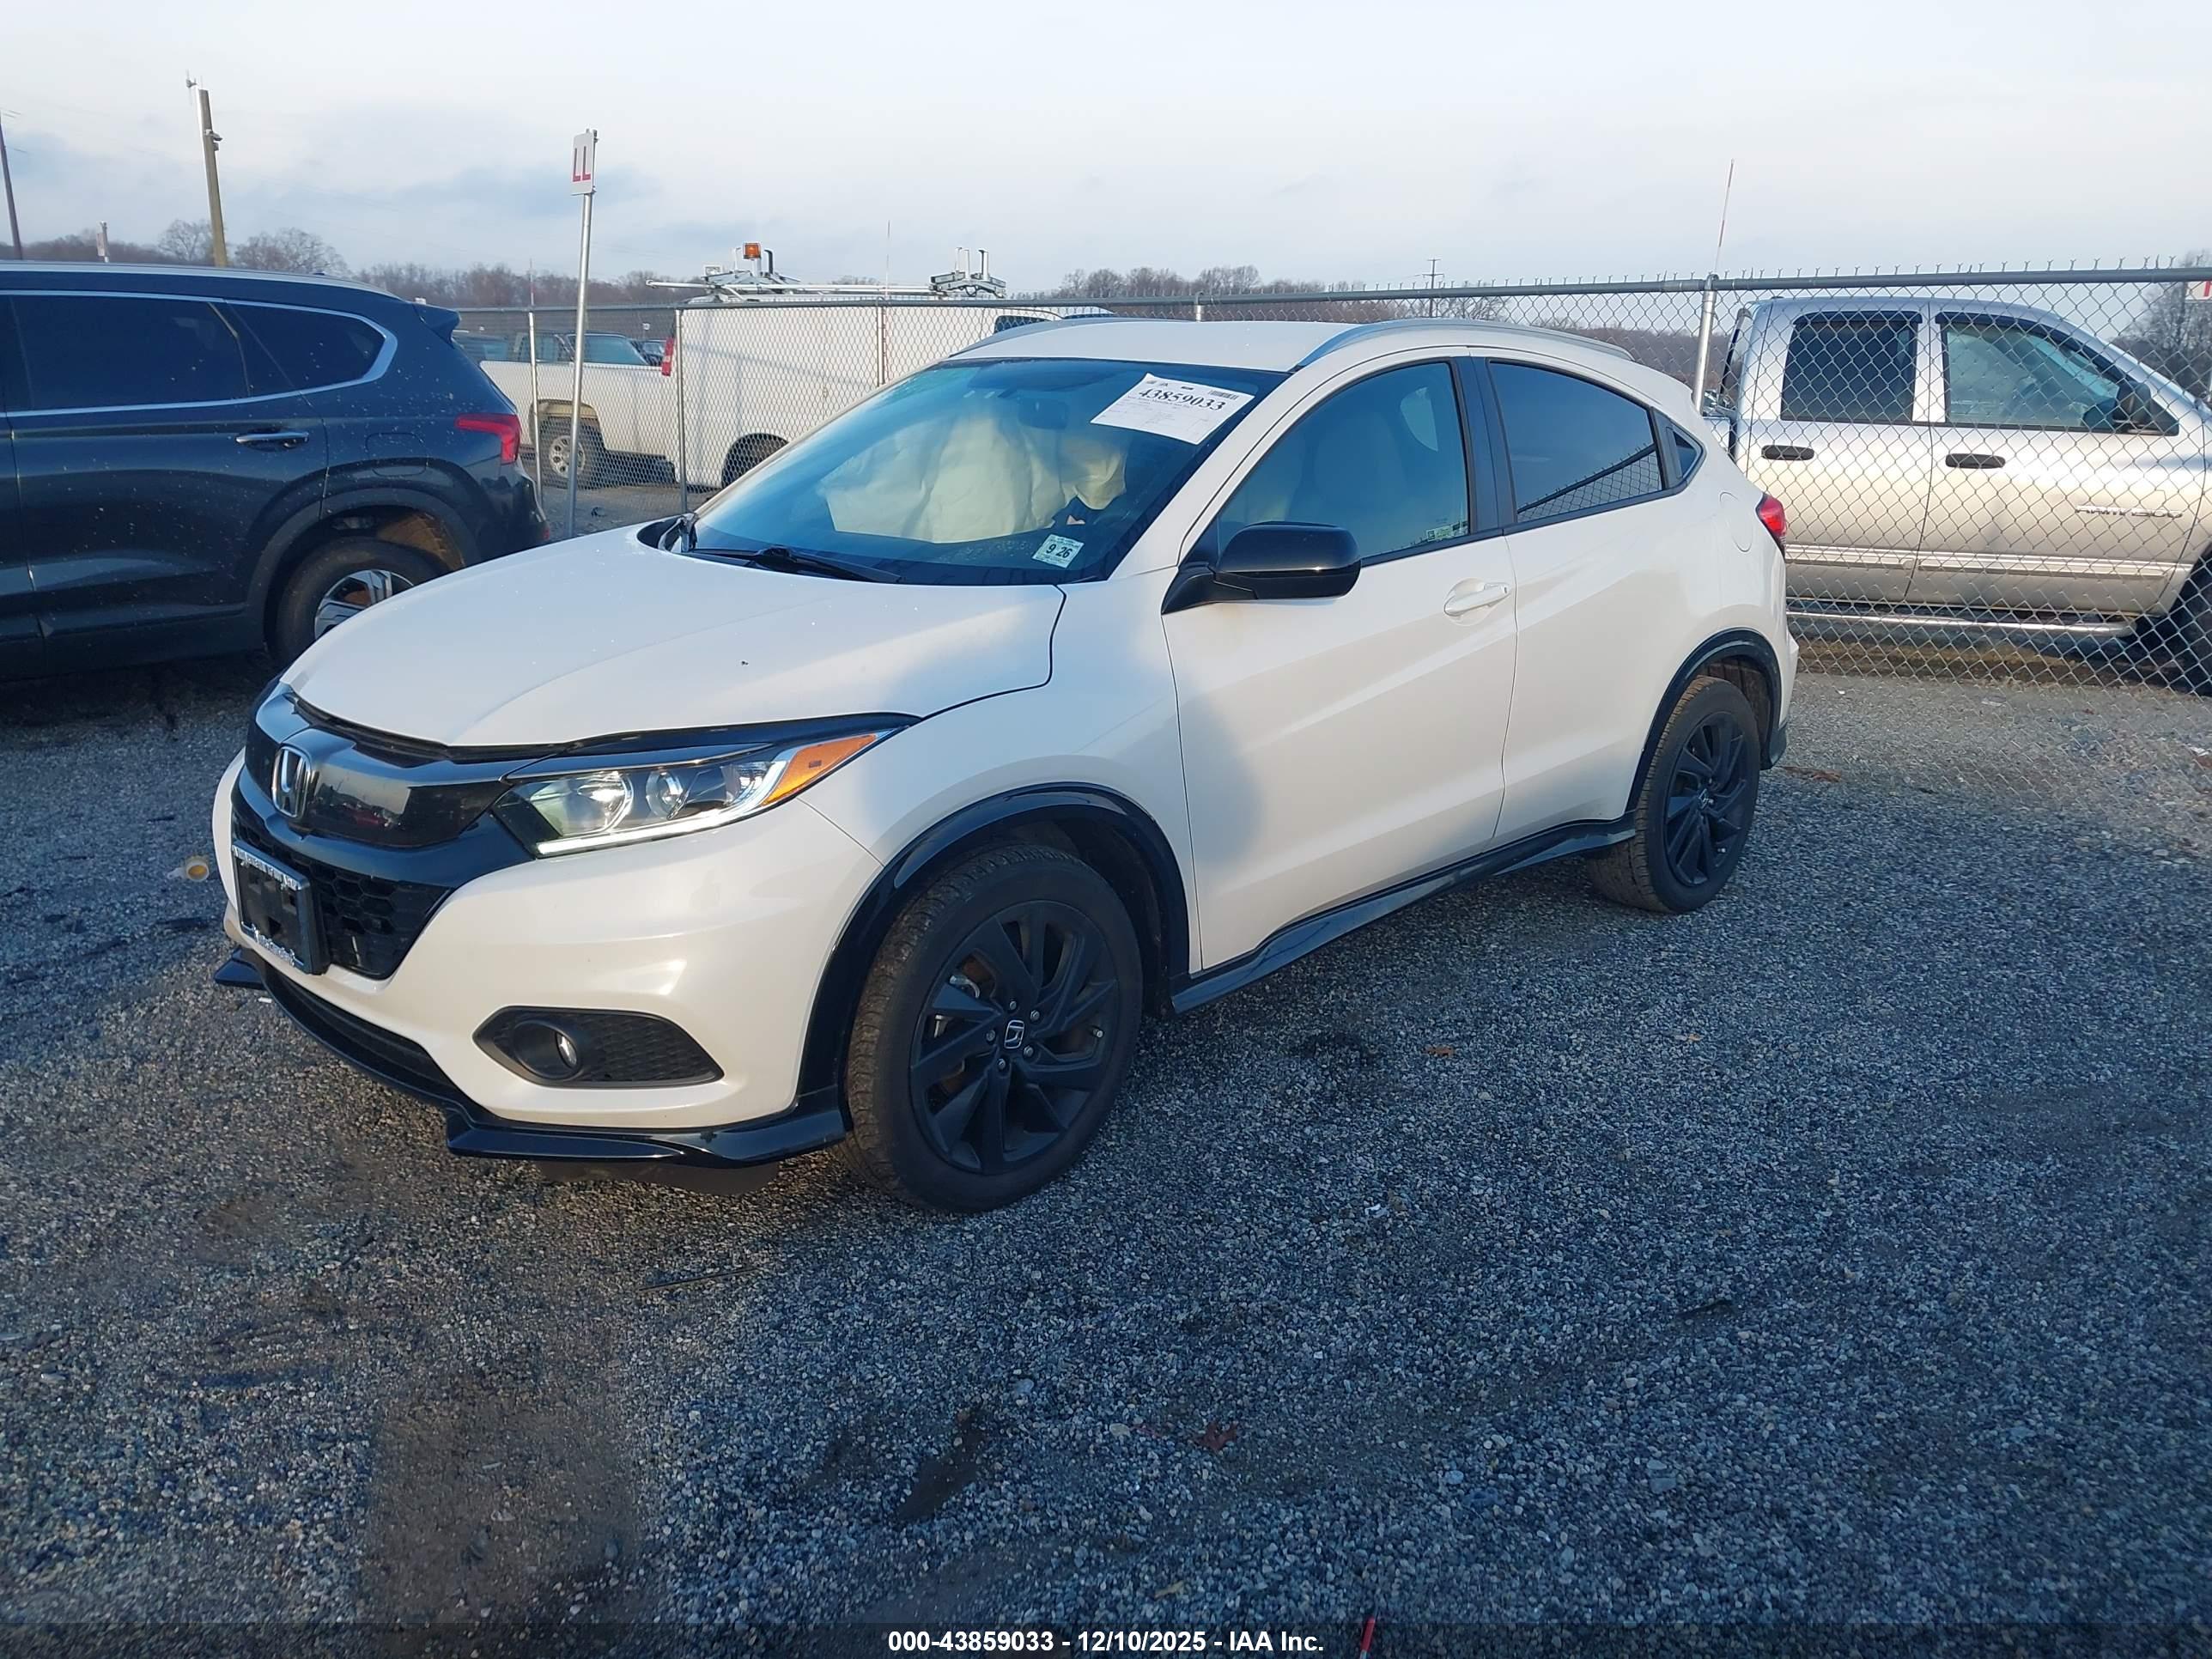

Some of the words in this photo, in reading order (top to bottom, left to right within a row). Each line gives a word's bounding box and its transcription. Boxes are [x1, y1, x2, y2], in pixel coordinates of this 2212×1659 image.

[572, 145, 591, 182] LL
[1138, 387, 1227, 411] 43859033
[1046, 544, 1057, 554] 9
[1055, 546, 1073, 558] 26
